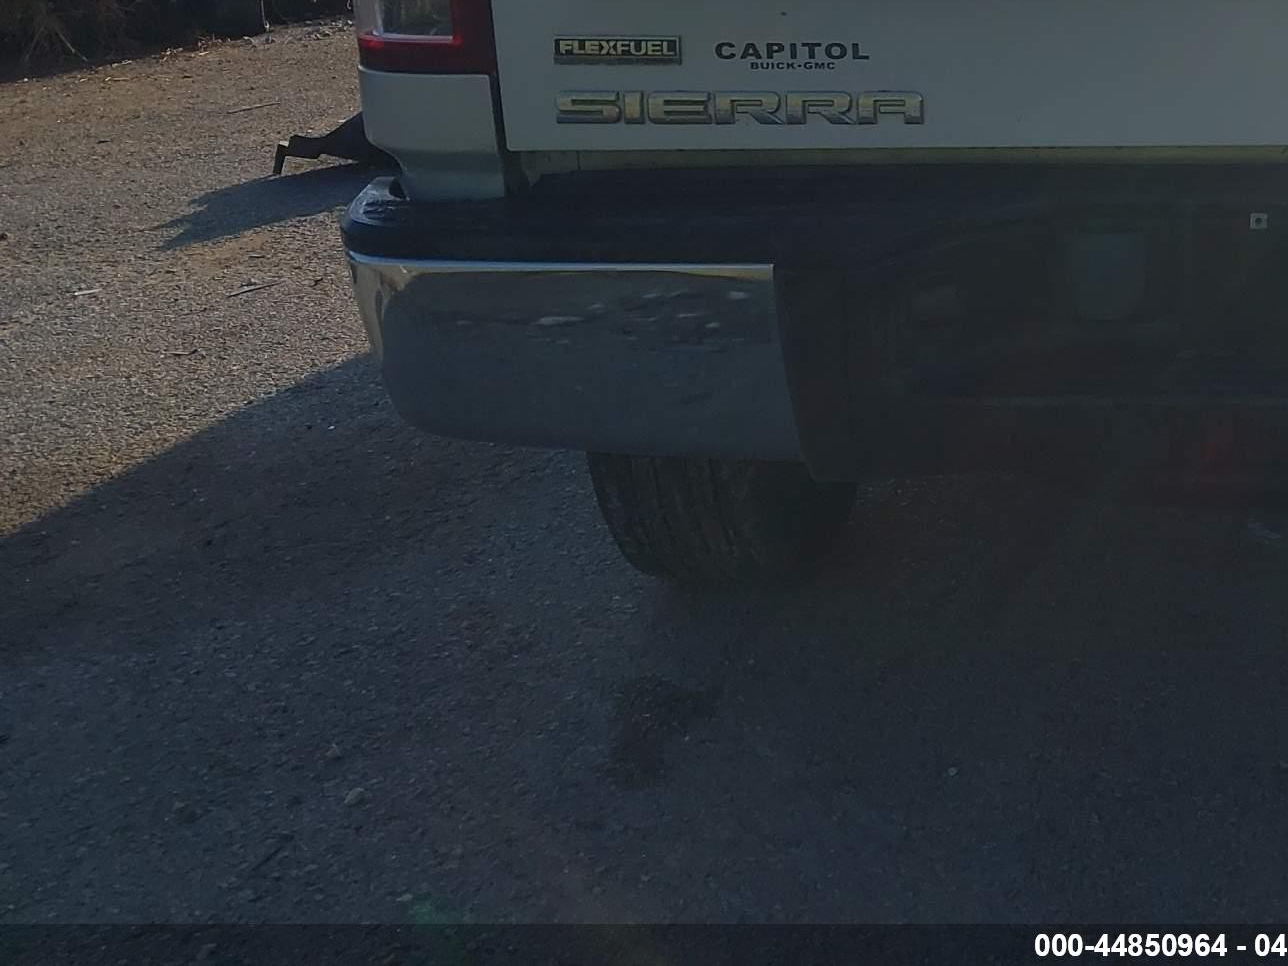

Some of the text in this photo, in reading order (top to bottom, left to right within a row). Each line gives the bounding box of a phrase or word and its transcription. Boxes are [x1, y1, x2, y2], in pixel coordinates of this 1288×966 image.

[559, 40, 676, 56] FLEXFUEL
[715, 42, 870, 60] CAPITOL
[554, 90, 925, 125] SIERRA
